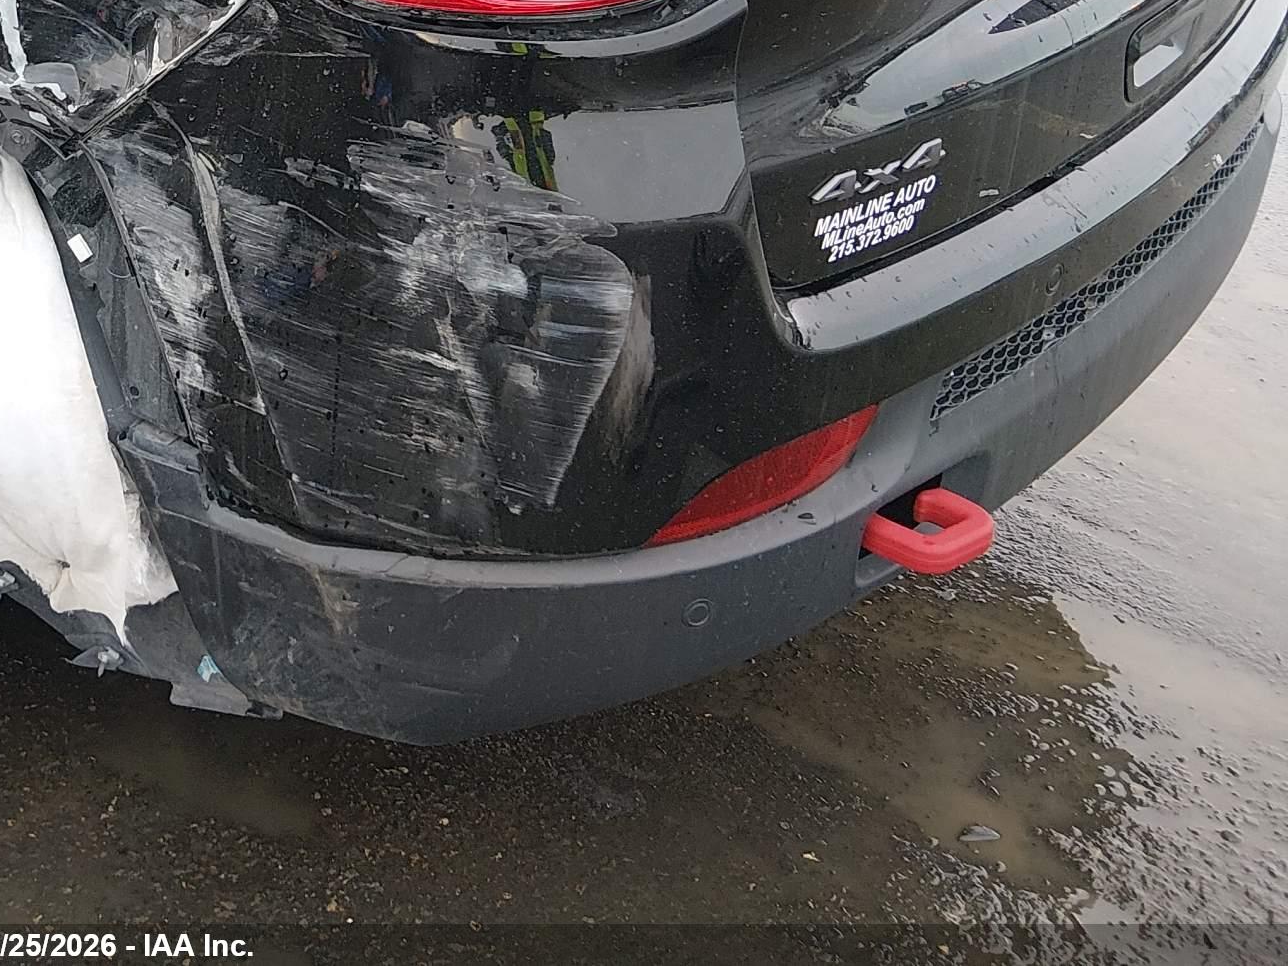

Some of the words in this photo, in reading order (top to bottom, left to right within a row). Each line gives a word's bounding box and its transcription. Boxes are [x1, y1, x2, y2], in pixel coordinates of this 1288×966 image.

[813, 191, 895, 237] MAINLINE
[892, 174, 937, 204] AUTO
[820, 198, 926, 250] MLineAuto.com
[827, 214, 915, 263] 215.372.9600
